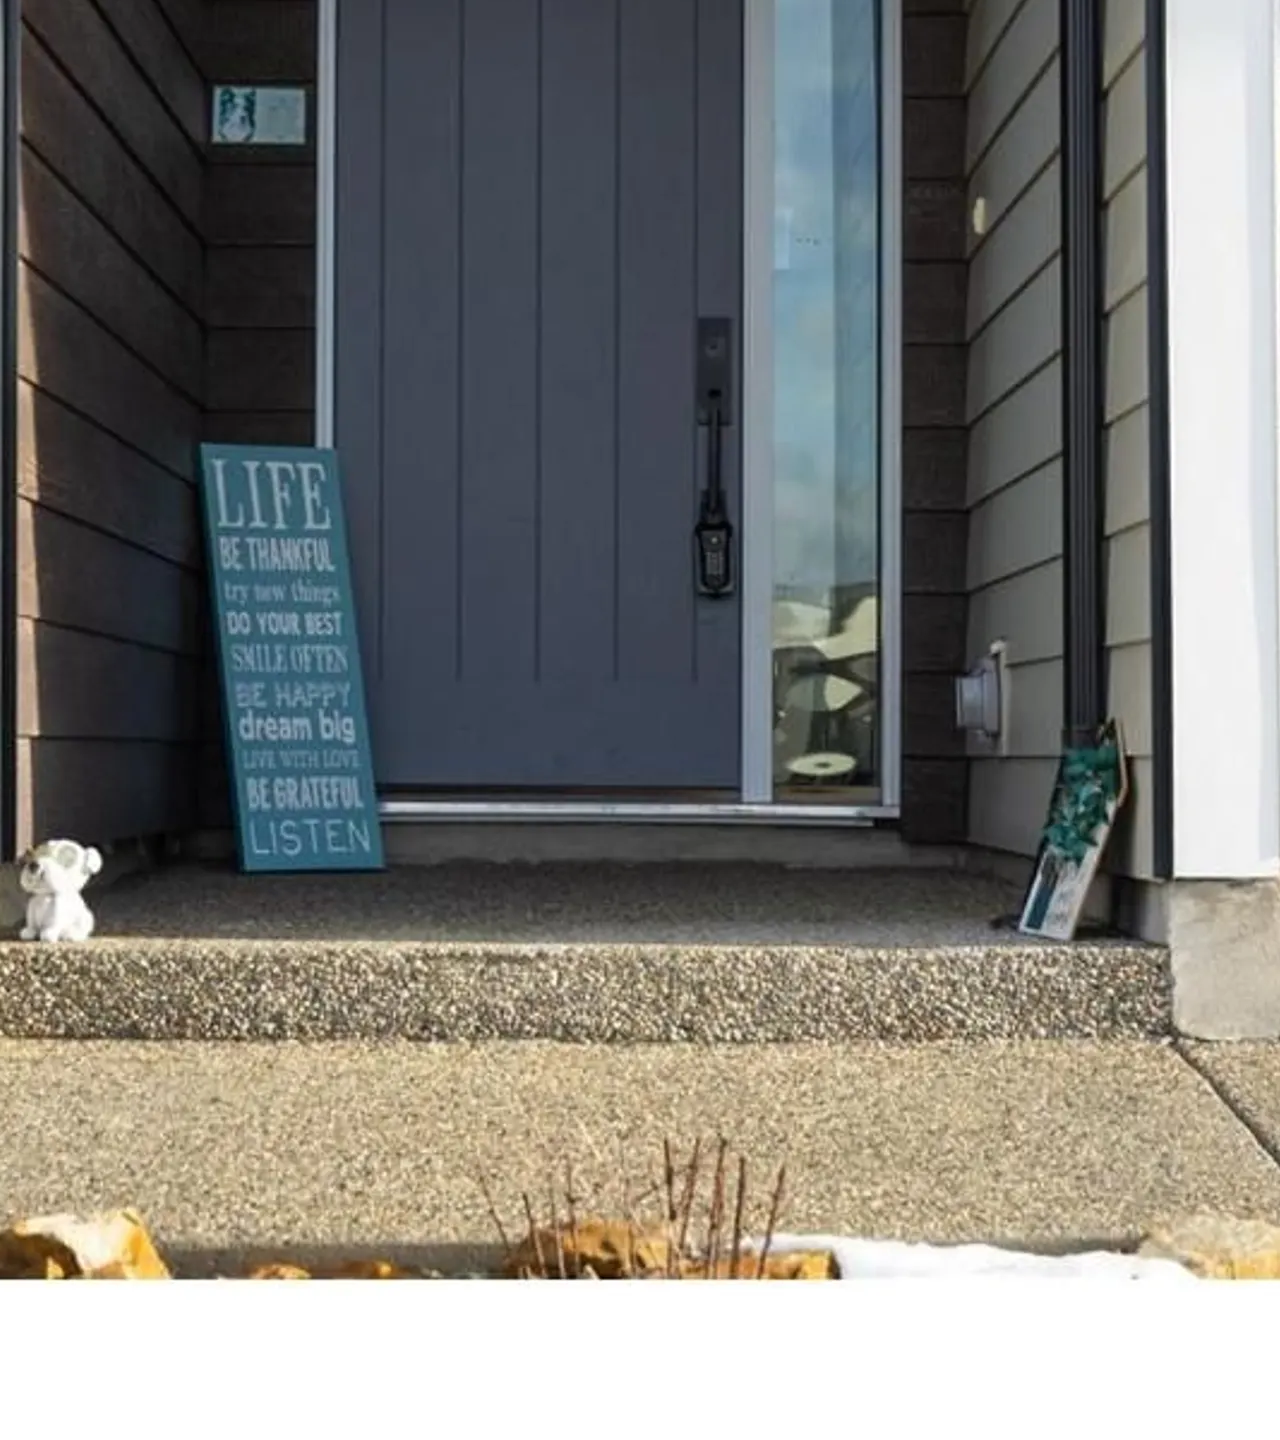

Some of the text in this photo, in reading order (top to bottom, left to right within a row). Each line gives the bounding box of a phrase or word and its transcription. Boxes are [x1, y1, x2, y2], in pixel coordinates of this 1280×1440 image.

[211, 458, 332, 530] LIFE
[219, 536, 336, 572] BE THANKFUL
[223, 578, 341, 607] try new things
[226, 611, 342, 635] DO YOUR BEST
[230, 644, 349, 673] SMILE OFTEN
[235, 681, 351, 708] BE HAPPY
[239, 707, 356, 744] dream big
[242, 749, 361, 769] LIVE WITH LOVE
[245, 775, 365, 810] BE GRATEFUL
[249, 818, 370, 855] LISTEN
